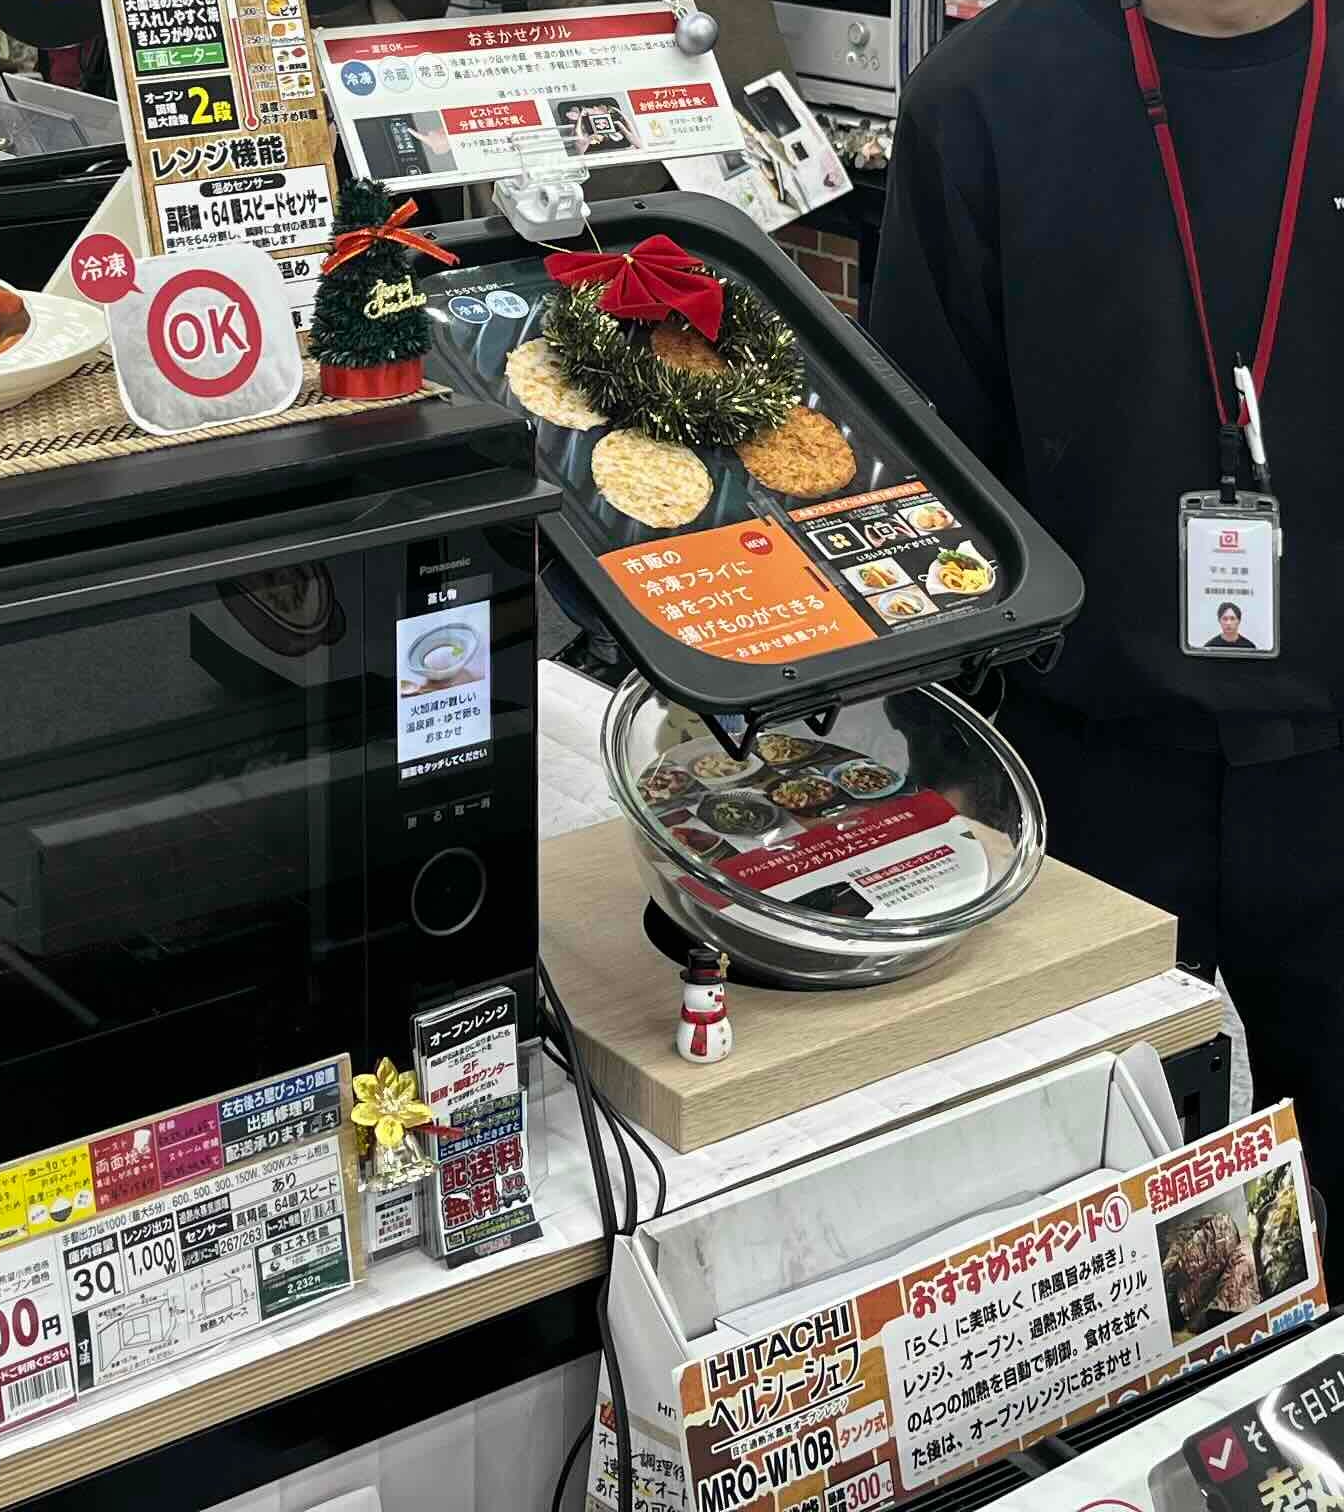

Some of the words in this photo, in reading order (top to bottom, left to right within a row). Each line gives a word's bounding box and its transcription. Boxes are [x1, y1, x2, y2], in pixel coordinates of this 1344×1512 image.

[136, 24, 217, 47] きムラが少ない
[467, 28, 573, 48] おまかせグリル
[141, 49, 218, 67] 平面ヒーター
[382, 67, 411, 85] 冷蔵
[418, 62, 447, 80] 常温
[345, 71, 375, 88] 冷凍
[187, 86, 233, 126] 2段
[468, 104, 510, 120] ビストロで
[152, 135, 286, 178] レンジ機能
[211, 177, 275, 195] 温めセンサー
[79, 254, 128, 282] 冷凍
[168, 307, 248, 362] OK
[744, 536, 769, 550] NEW
[419, 556, 472, 576] Panasonic
[623, 550, 681, 575] 市販の
[640, 560, 753, 598] 冷凍フライに
[658, 586, 754, 622] 油をつけて
[677, 594, 825, 646] 揚げものができる
[786, 832, 889, 874] ワンボウルメニュー
[430, 1003, 509, 1047] オーブンレンジ
[463, 1058, 480, 1076] 2F
[221, 1066, 337, 1119] 左右後ろ壁ぴったり設置
[247, 1094, 316, 1132] 出張修理可
[224, 1119, 309, 1165] 配送承ります
[271, 1171, 298, 1194] あり
[441, 1133, 523, 1194] 配送料
[1147, 1125, 1275, 1216] 熱風旨み焼き
[443, 1178, 499, 1230] 無料
[123, 1217, 174, 1246] レンジ出力
[184, 1220, 229, 1244] センサー
[271, 1226, 331, 1256] 省エネ性能
[128, 1238, 177, 1276] 1,000W
[902, 1244, 1138, 1364] 「らく」に美味しく「熱風旨み焼き」。
[707, 1303, 852, 1390] HITACHI
[902, 1271, 1148, 1399] レンジ、オーブン、過熱水蒸気、グリル
[711, 1340, 861, 1435] ヘルシーシェフ
[906, 1306, 1151, 1435] の4つの加熱を自動で制御。食材を並べ
[838, 1413, 889, 1448] タンク式
[697, 1429, 836, 1511] MRO-W10B
